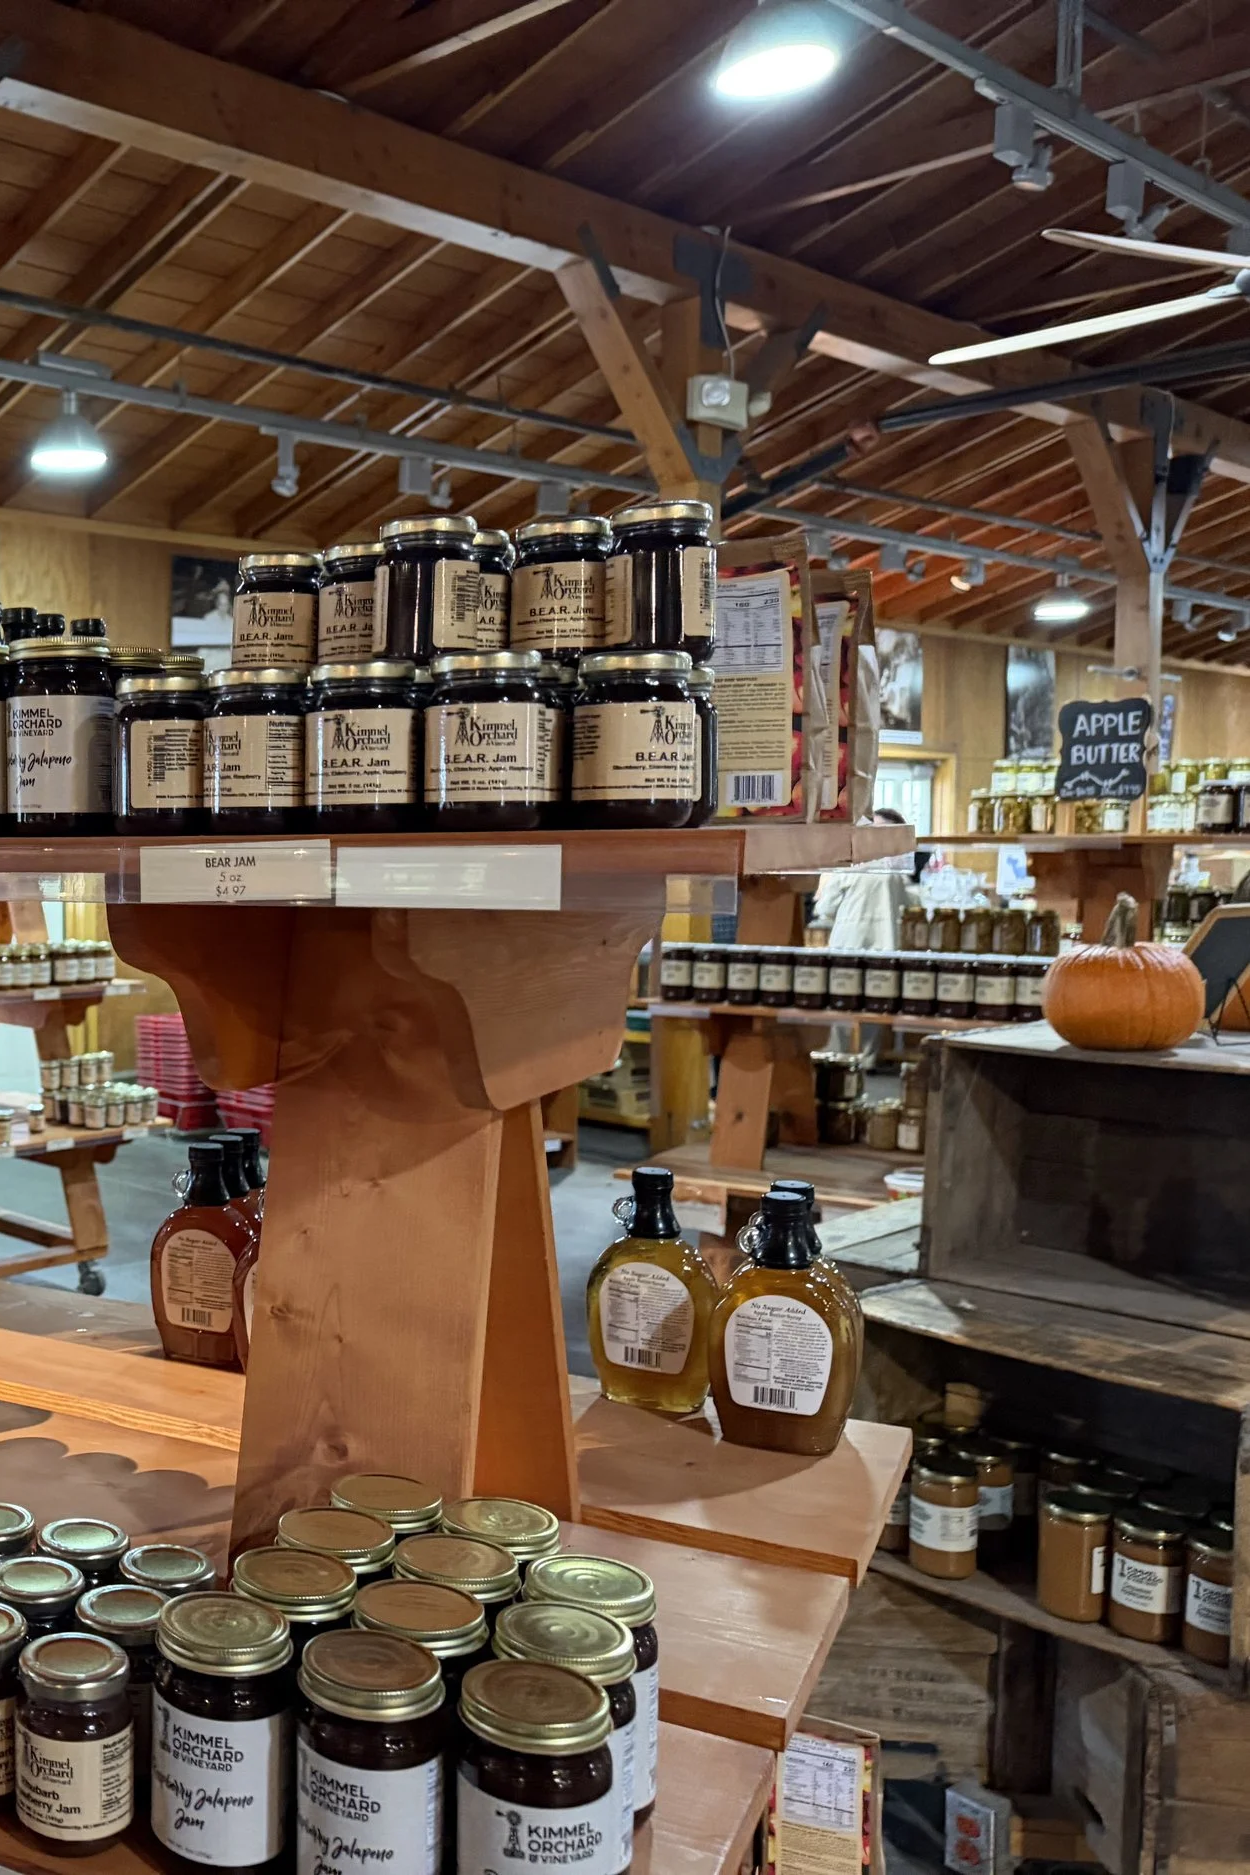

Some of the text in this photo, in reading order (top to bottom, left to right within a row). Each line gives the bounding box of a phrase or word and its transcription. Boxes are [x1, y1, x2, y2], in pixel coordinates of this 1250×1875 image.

[554, 574, 593, 589] Kimmel
[553, 585, 595, 600] Orchard
[258, 603, 293, 615] Kimmel
[530, 606, 570, 617] B.E.A.R.
[258, 613, 294, 627] Orchard
[12, 708, 54, 718] KIMMEL
[13, 719, 62, 729] ORCHARD
[345, 723, 388, 737] Kimmel
[470, 717, 515, 732] Kimmel
[1072, 710, 1142, 738] APPLE
[346, 734, 390, 750] Orchard
[470, 728, 518, 746] Orchard
[367, 758, 390, 767] Jam
[492, 753, 517, 763] Jam
[1070, 743, 1141, 766] BUTTER
[28, 750, 72, 776] Jalapeno
[221, 763, 240, 772] Jam
[205, 856, 256, 868] BEAR JAM
[230, 874, 242, 882] oz
[173, 1724, 234, 1750] KIMMEL
[30, 1745, 70, 1769] Kimmel
[173, 1740, 244, 1764] ORCHARD
[30, 1762, 73, 1779] Orchard
[180, 1755, 233, 1772] VINEYARD
[310, 1765, 369, 1799] KIMMEL
[194, 1787, 254, 1812] Jalapeno
[310, 1781, 381, 1814] ORCHARD
[56, 1804, 81, 1814] Jam
[318, 1798, 369, 1823] VINEYARD
[174, 1808, 204, 1830] Jam
[528, 1822, 594, 1839] KIMMEL
[333, 1837, 394, 1864] Jalapeno
[528, 1832, 602, 1853] ORCHARD
[542, 1850, 594, 1864] VINEYARD
